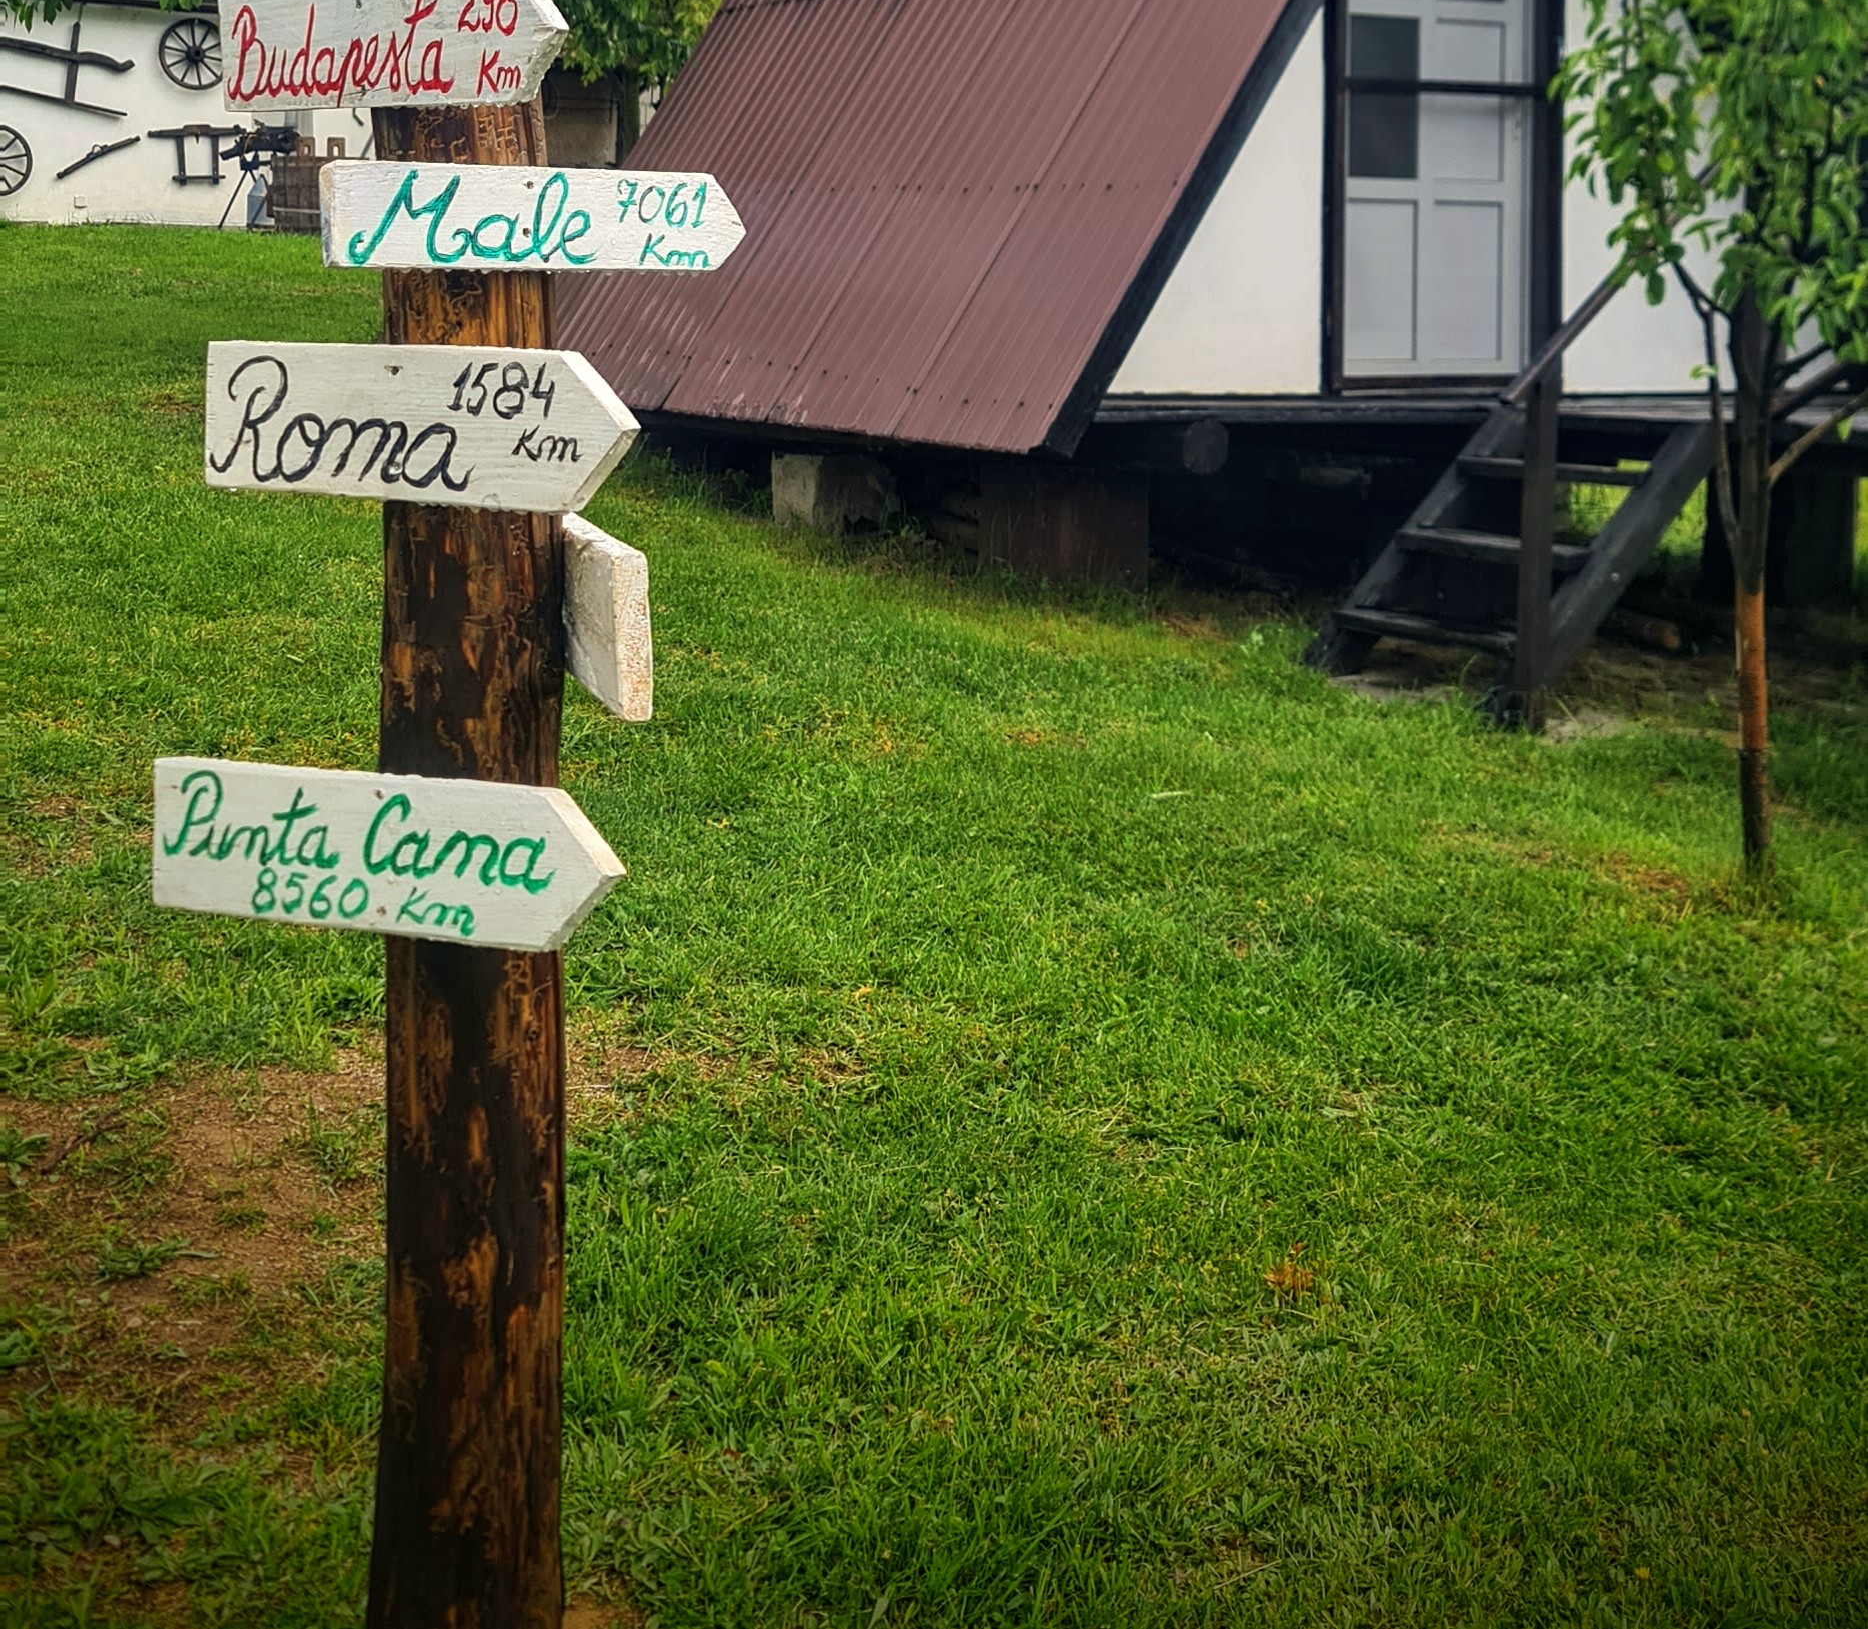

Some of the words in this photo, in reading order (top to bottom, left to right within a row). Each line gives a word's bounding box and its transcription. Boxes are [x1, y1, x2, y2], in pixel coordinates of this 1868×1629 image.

[347, 168, 599, 267] Male
[616, 177, 708, 229] 7061
[209, 355, 477, 492] Roma
[447, 360, 556, 420] 1584
[163, 769, 341, 869] Punta
[251, 867, 369, 920] 8560
